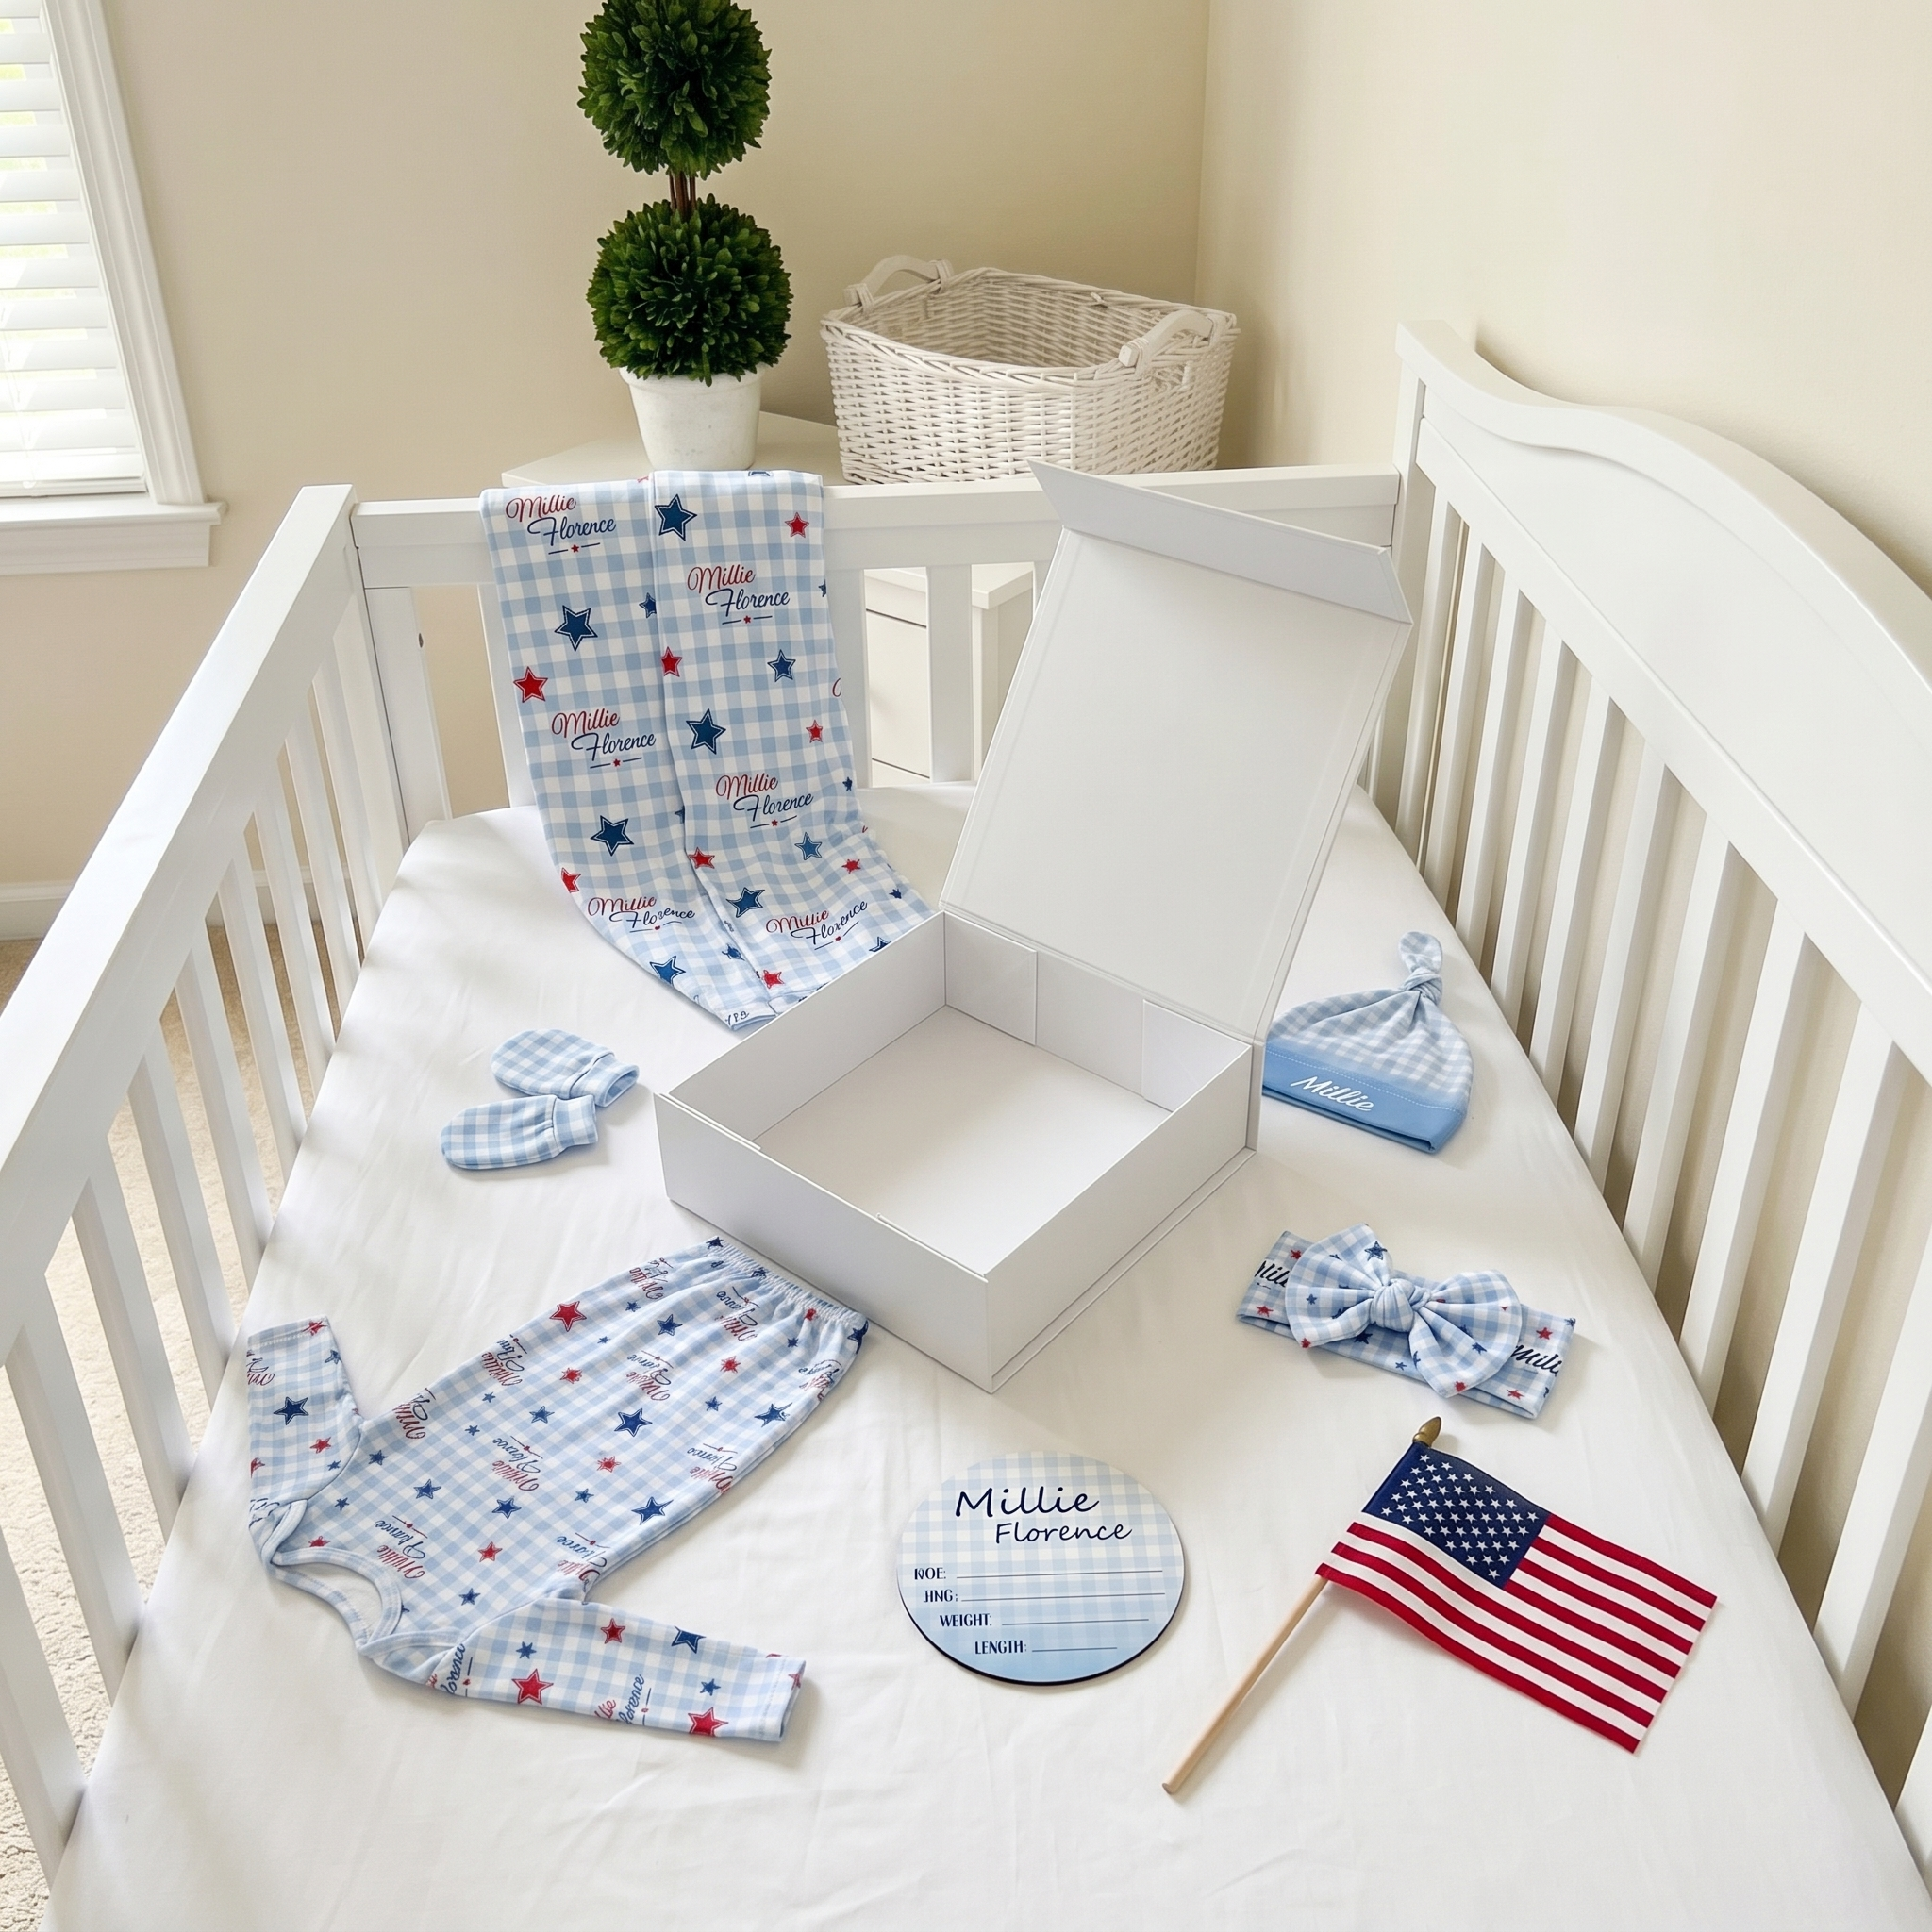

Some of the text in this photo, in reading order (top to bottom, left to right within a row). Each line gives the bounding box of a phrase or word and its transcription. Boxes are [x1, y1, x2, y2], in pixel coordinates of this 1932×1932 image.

[506, 494, 577, 523] Millie
[527, 516, 617, 546] Florence
[687, 564, 756, 594] Millie
[705, 588, 791, 617] Florence
[551, 708, 620, 738] Millie
[571, 732, 657, 761] Florence
[716, 773, 779, 800] Millie
[733, 793, 814, 822] Florence
[588, 896, 657, 916] Millie
[1290, 1075, 1374, 1112] Millie
[955, 1486, 1100, 1518] Millie
[995, 1522, 1133, 1544] Florence
[940, 1613, 992, 1627] WEIGHT:
[974, 1640, 1027, 1655] LENGTH:
